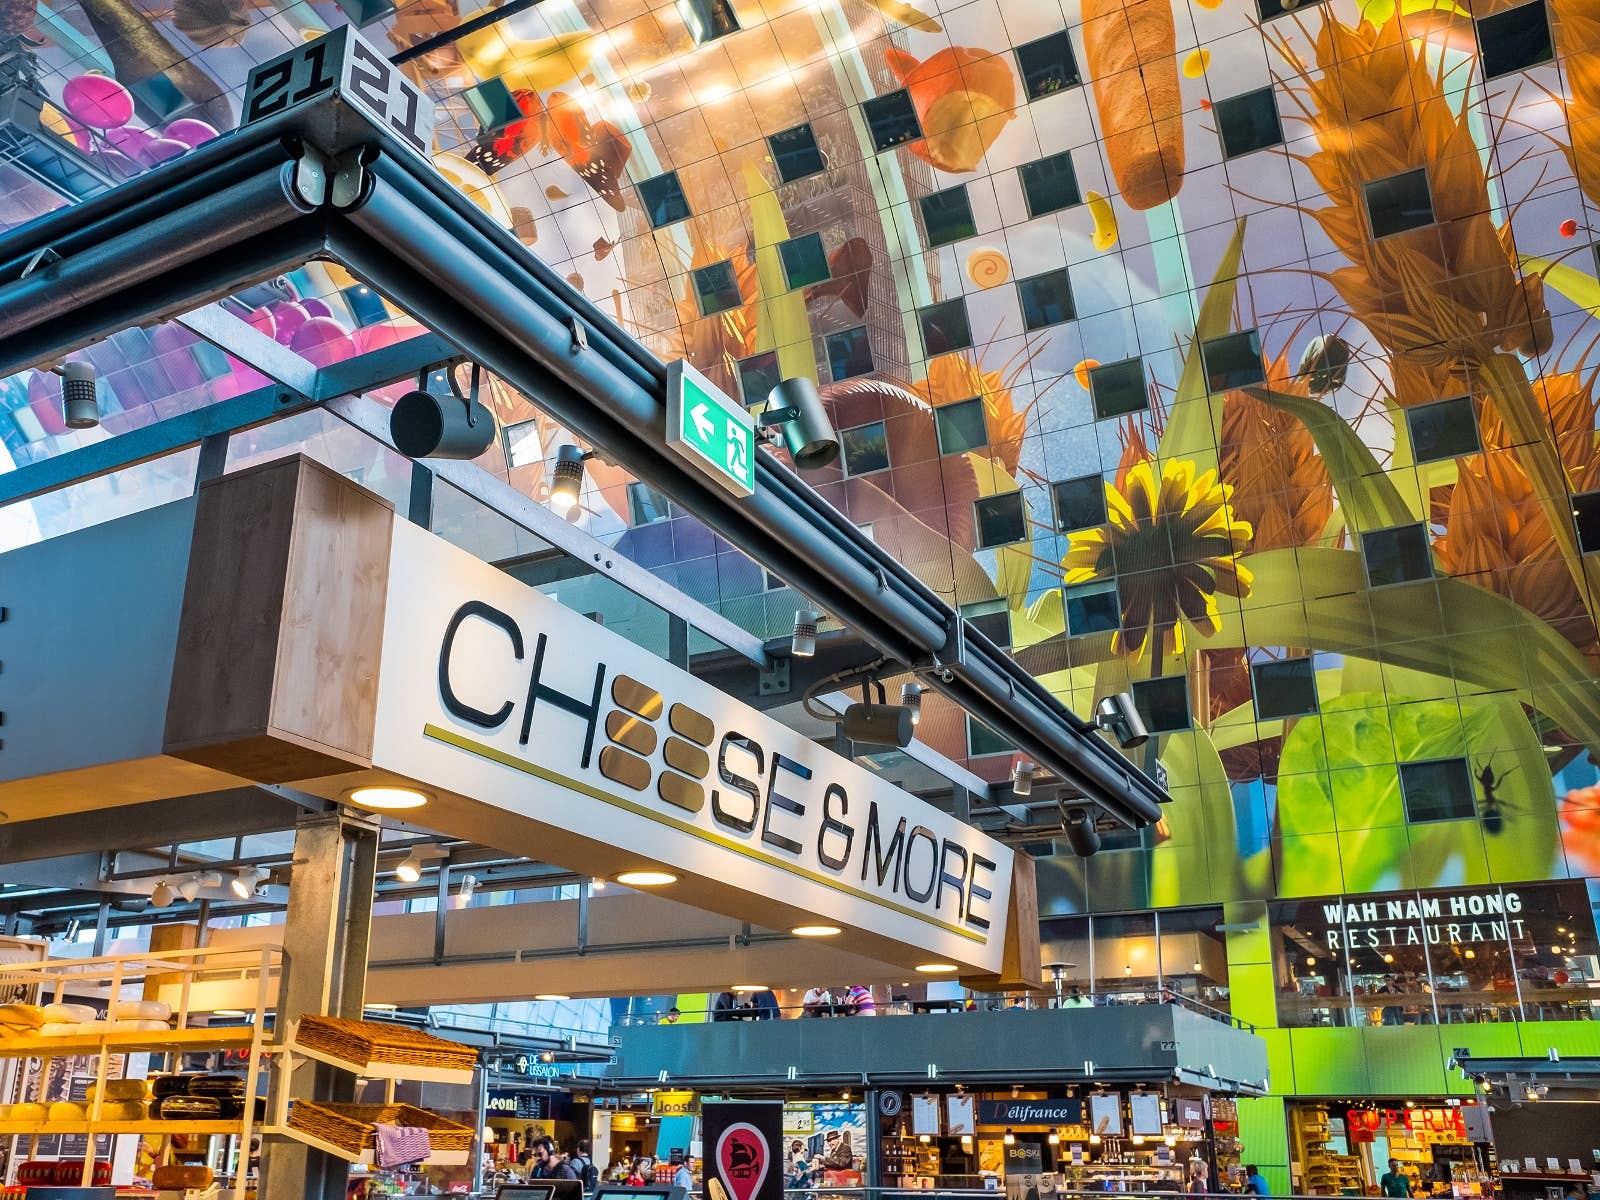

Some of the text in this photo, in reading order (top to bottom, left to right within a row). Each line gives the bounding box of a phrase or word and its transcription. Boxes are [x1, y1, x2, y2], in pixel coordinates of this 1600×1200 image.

[248, 43, 334, 123] 21
[350, 39, 426, 153] 21
[818, 782, 854, 871] &
[861, 800, 997, 928] MORE
[1322, 892, 1522, 925] WAH NAM HONG
[1326, 919, 1525, 950] RESTAURANT
